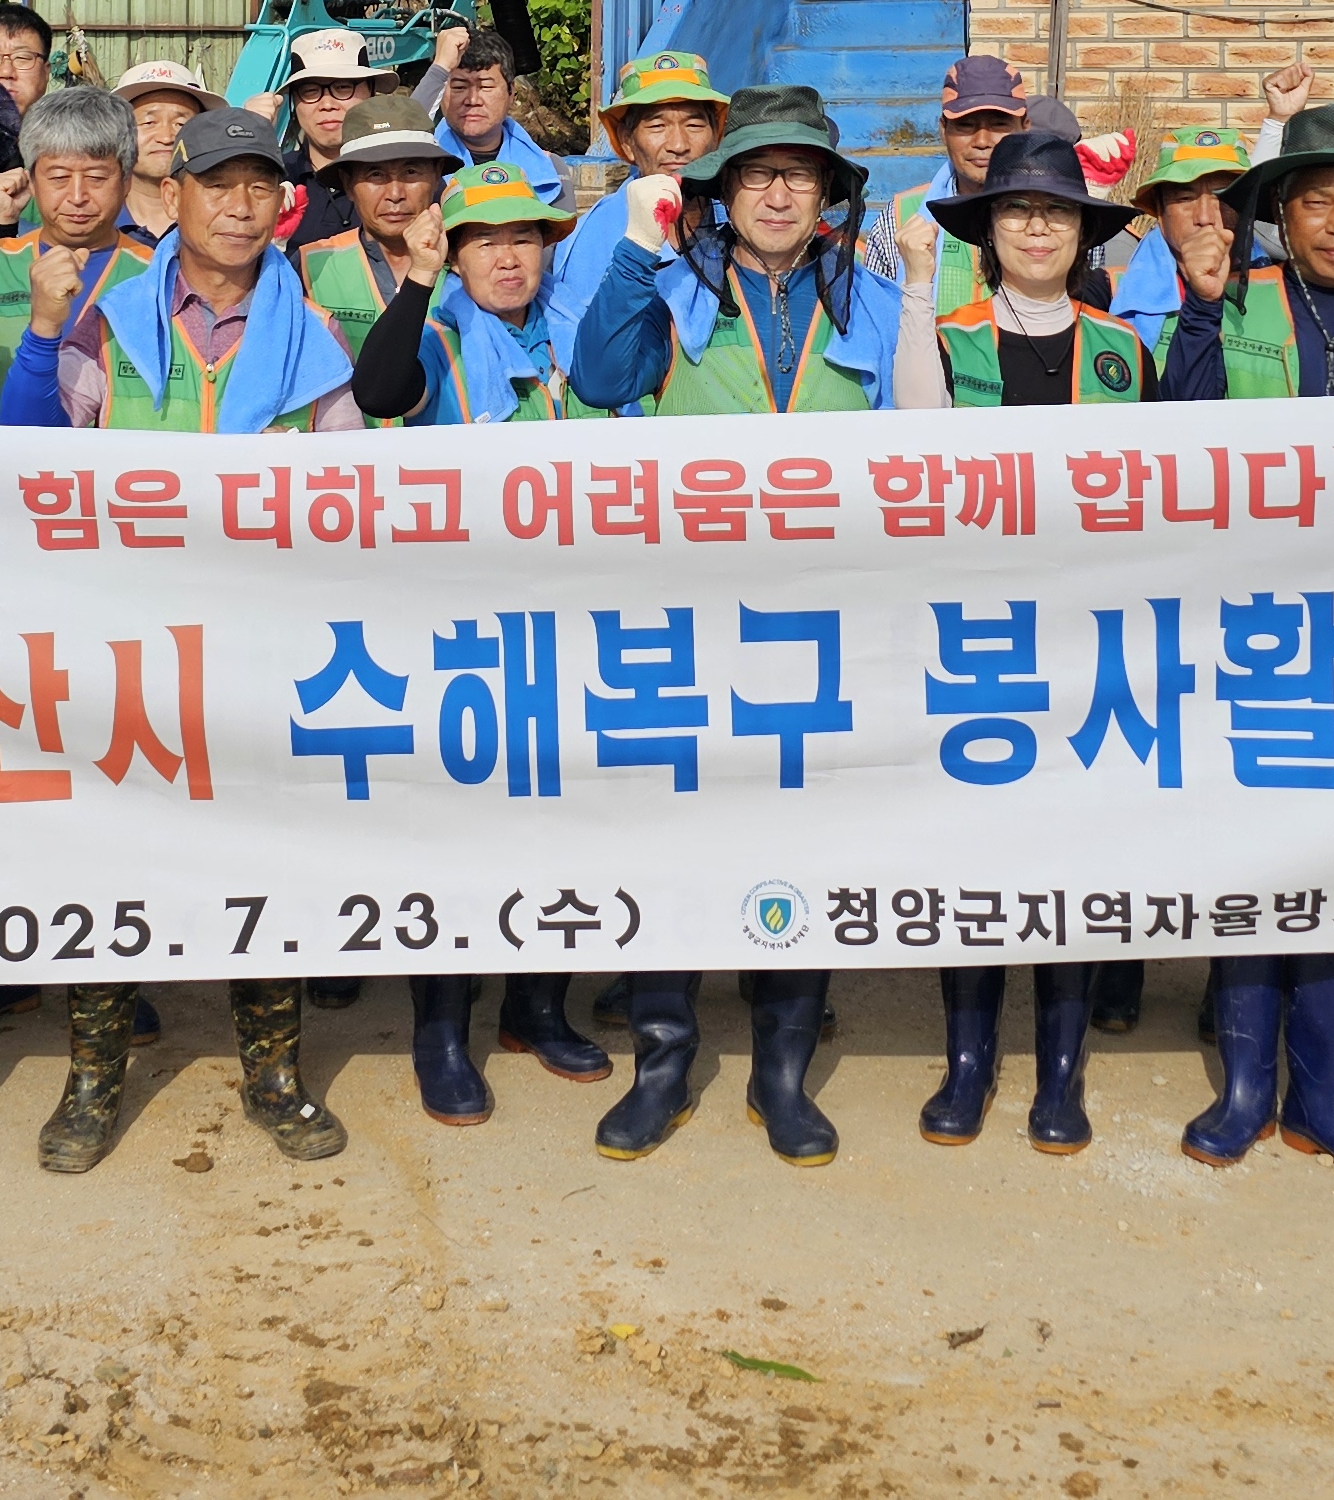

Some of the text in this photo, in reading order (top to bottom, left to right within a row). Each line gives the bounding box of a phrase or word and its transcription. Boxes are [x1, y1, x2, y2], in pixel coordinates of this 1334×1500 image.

[367, 36, 395, 61] ELCO
[1227, 338, 1281, 356] 청양군자율방재
[19, 470, 187, 551] 힘은
[216, 465, 470, 549] 더하고
[503, 458, 840, 546] 어려움은
[868, 452, 1036, 536] 함께
[290, 605, 854, 800] 수해복구
[768, 879, 788, 887] ACTIVE
[224, 896, 299, 955] 7.
